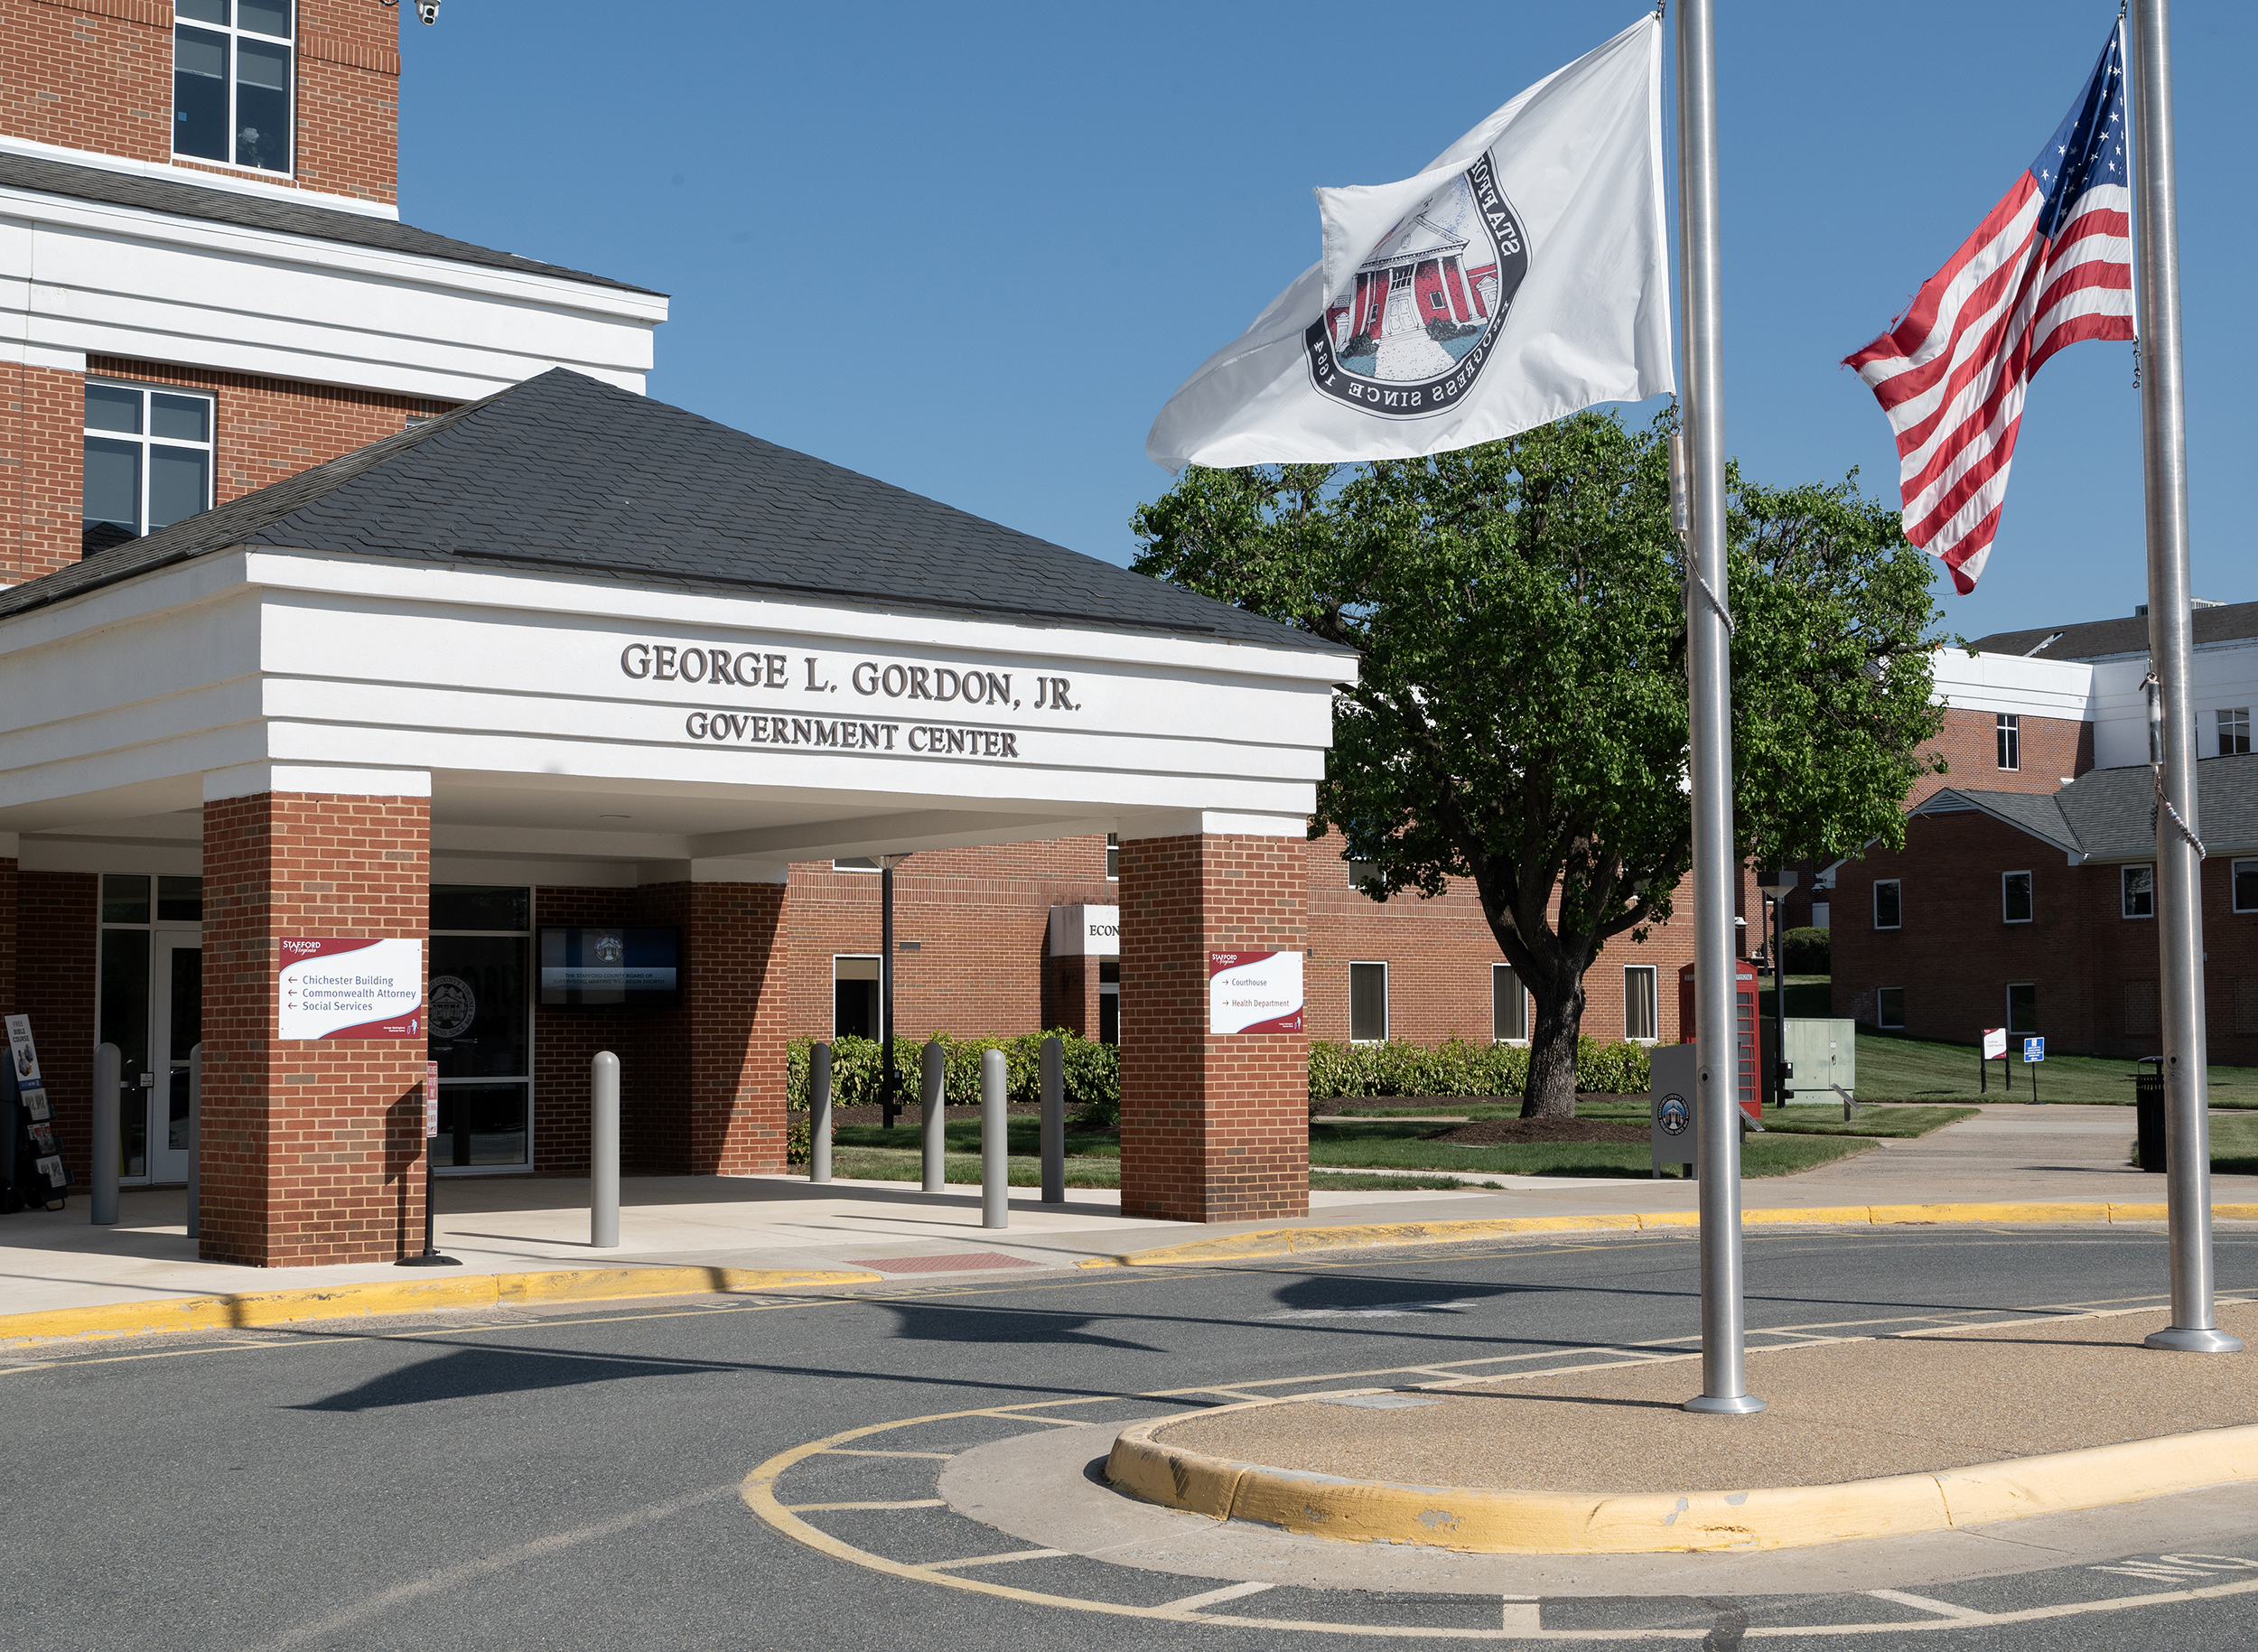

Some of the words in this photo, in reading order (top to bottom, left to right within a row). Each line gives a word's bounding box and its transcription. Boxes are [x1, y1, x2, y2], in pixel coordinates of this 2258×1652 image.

[620, 643, 789, 689] GEORGE
[804, 657, 837, 694] L.
[852, 661, 1022, 711] GORDON,
[1034, 677, 1082, 712] JR.
[686, 712, 900, 751] GOVERNMENT
[908, 725, 1020, 758] CENTER
[283, 940, 322, 948] STAFFORD
[289, 944, 317, 956] Virginia
[1211, 953, 1237, 961] STAFFORD
[303, 975, 353, 985] Chichester
[356, 975, 394, 987] Building
[1231, 978, 1267, 986] Courthouse
[303, 988, 375, 998] Commonwealth
[378, 989, 416, 1000] Attorney
[303, 1002, 331, 1011] Social
[334, 1002, 373, 1011] Services
[1232, 999, 1252, 1007] Health
[1254, 999, 1290, 1009] Department
